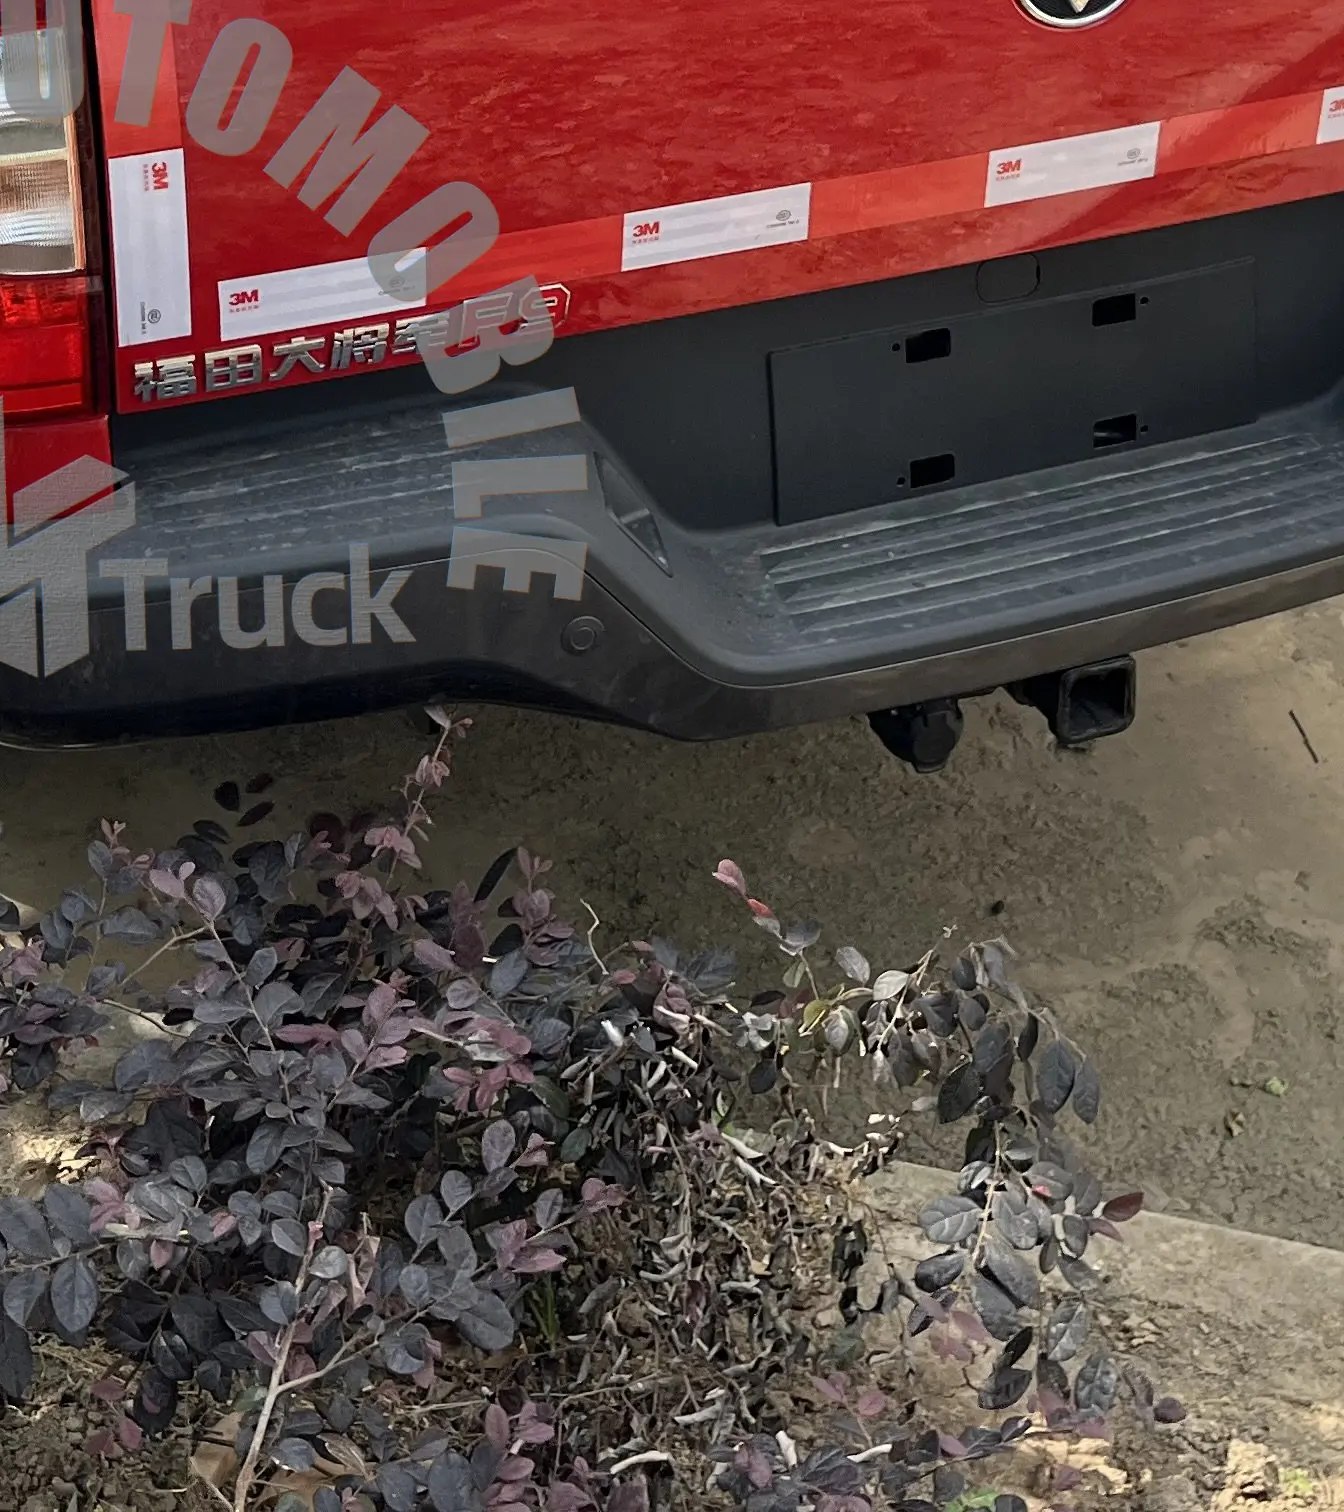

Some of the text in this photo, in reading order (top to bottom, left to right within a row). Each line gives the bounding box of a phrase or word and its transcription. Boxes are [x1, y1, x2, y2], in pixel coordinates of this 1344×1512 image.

[996, 158, 1022, 175] 3M
[152, 162, 169, 190] 3M
[632, 221, 660, 237] 3M
[229, 289, 259, 306] 3M
